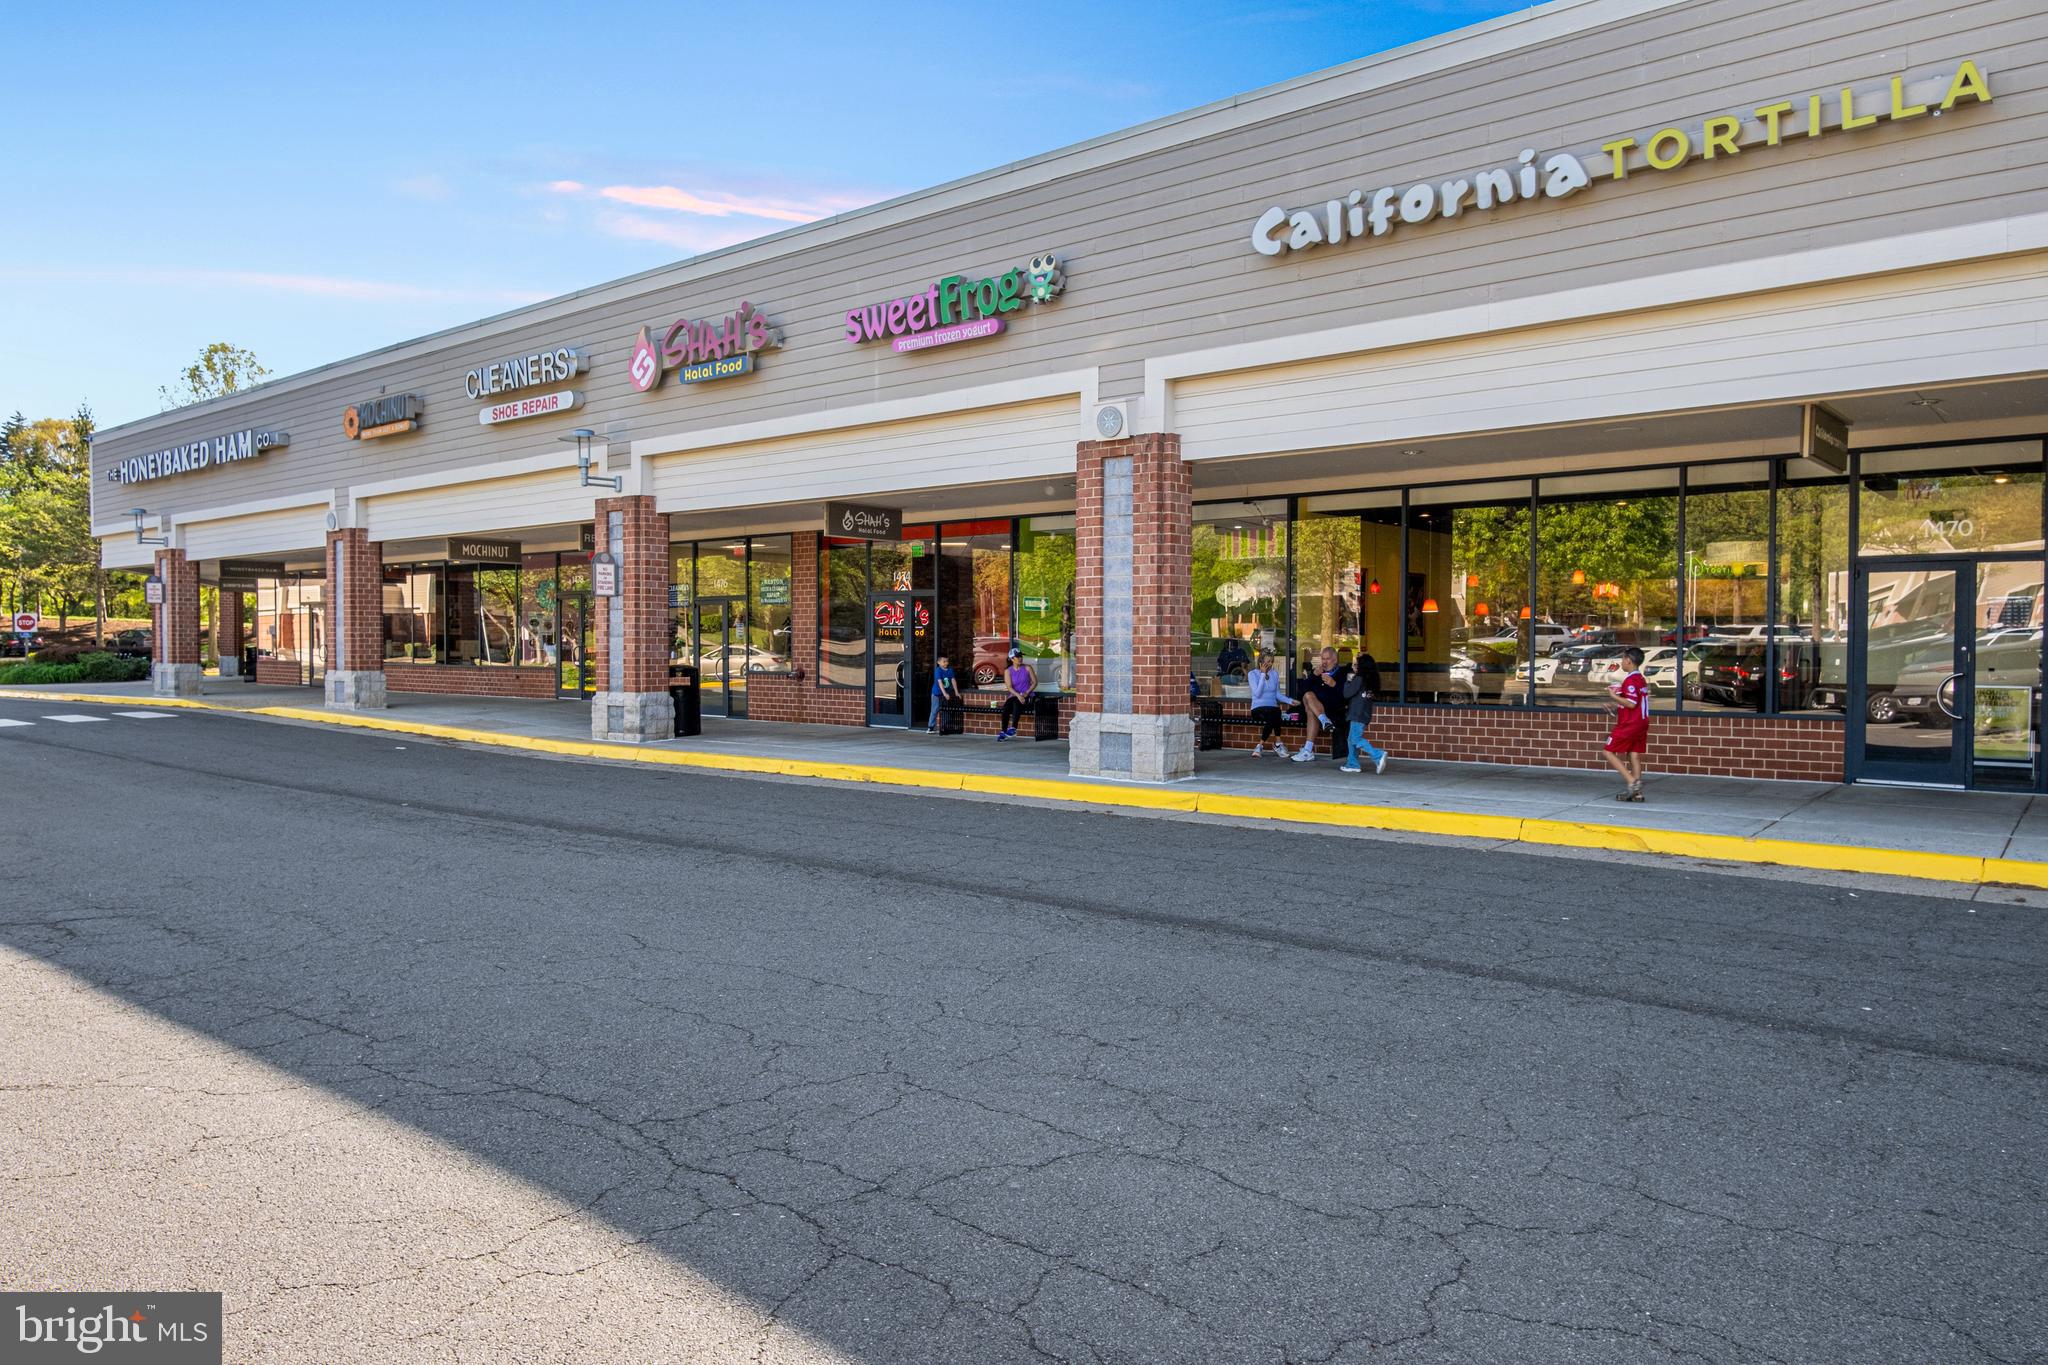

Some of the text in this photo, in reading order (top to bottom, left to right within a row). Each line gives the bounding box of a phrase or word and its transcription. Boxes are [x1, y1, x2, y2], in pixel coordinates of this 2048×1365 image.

[1251, 60, 1992, 256] California TORTILLA
[898, 322, 992, 351] premium frozen yogurt
[465, 347, 570, 400] CLEANERS
[684, 358, 742, 381] Halal Food
[492, 395, 559, 421] SHOE REPAIR
[120, 441, 209, 485] HONEYBAKED
[215, 429, 253, 464] HAM
[256, 432, 272, 449] CO.
[1924, 519, 1973, 537] 1470
[462, 543, 510, 558] MOCHINUT
[879, 628, 901, 636] Halal
